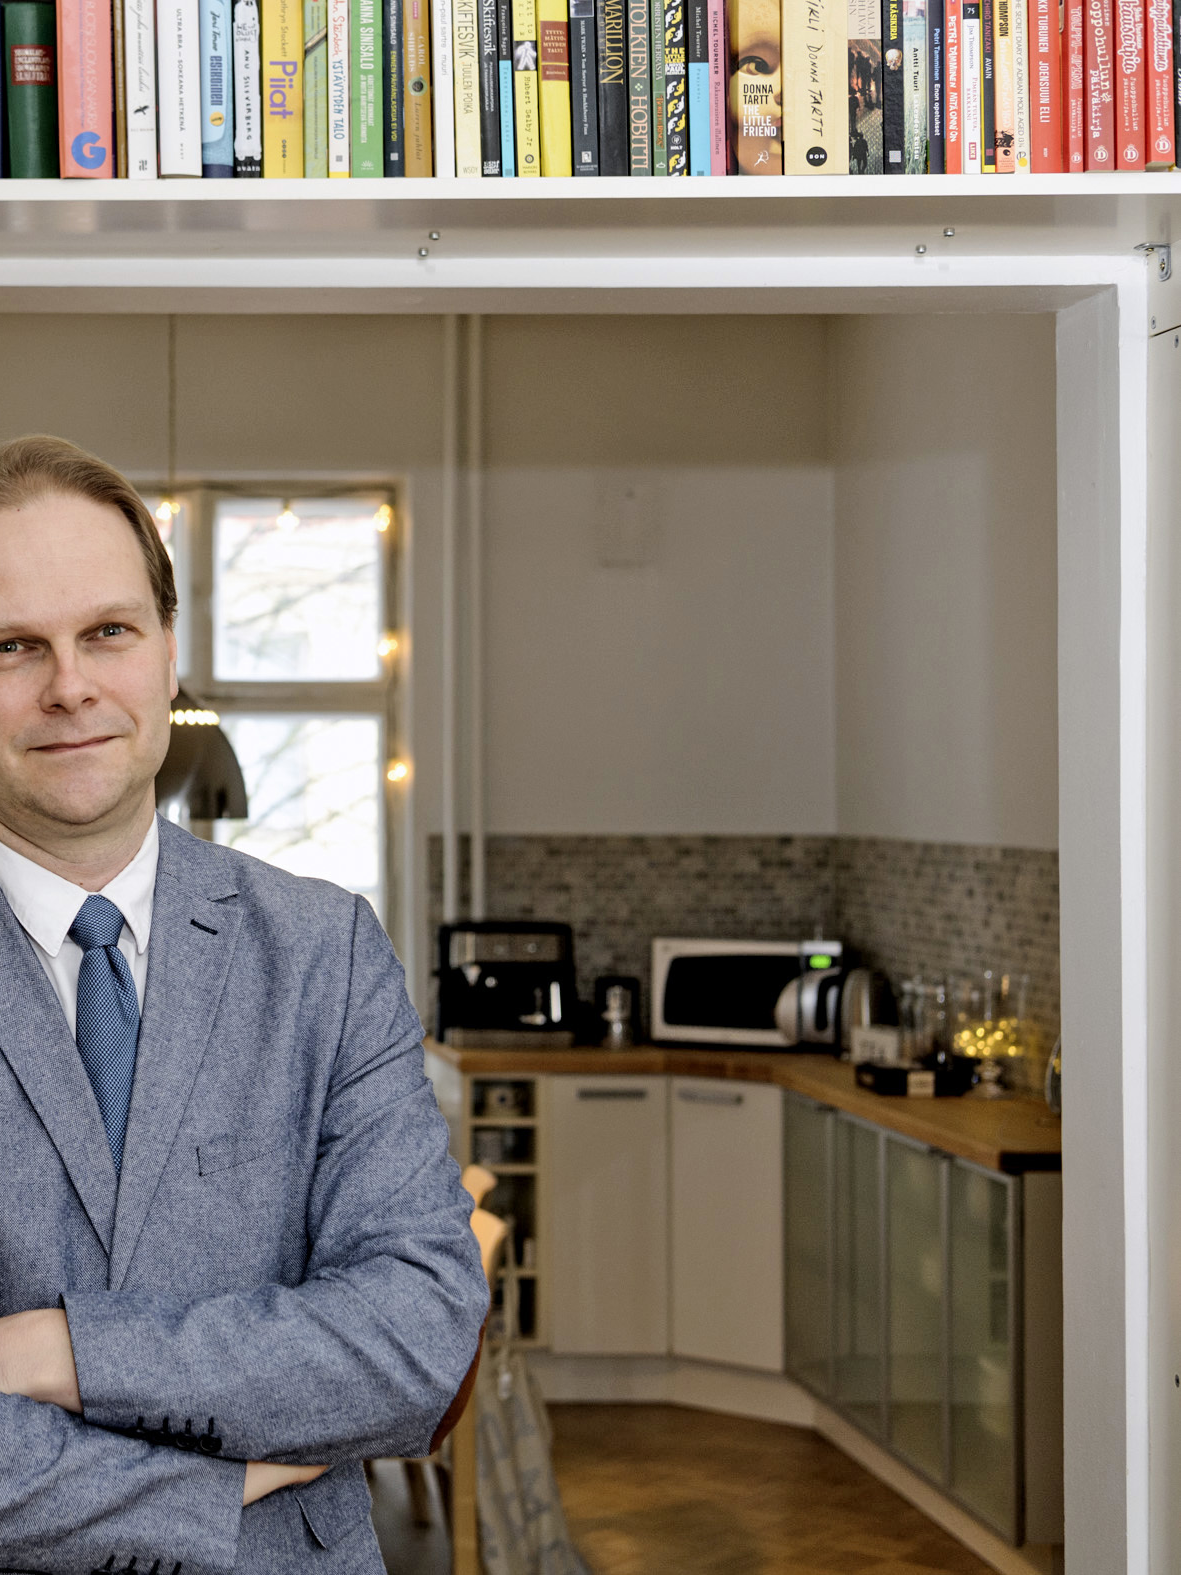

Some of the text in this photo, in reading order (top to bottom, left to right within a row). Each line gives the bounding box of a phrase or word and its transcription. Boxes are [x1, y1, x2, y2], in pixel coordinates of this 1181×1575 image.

[482, 0, 496, 56] Skiftesvik
[890, 3, 899, 41] KÄSIKIRJA
[967, 7, 975, 15] 75
[999, 0, 1009, 37] HOMPSON
[360, 27, 375, 70] SINISALO
[500, 5, 508, 56] Françoise Sagan
[695, 6, 704, 58] Michel Tournier
[1016, 36, 1024, 57] DIARY
[1038, 15, 1049, 53] TURUNEN
[407, 31, 416, 73] SHIELDS
[417, 35, 426, 67] CAROL
[440, 26, 449, 76] sartre muuri
[654, 40, 664, 81] HERRASTA
[912, 47, 920, 68] Antti
[985, 21, 993, 80] TANIZAKI AVAIN
[1017, 57, 1024, 67] OF
[177, 59, 185, 95] SOKEANA
[209, 55, 224, 106] esikoinen
[270, 26, 298, 119] Stockett Piiat
[332, 59, 346, 115] YSTÄVYYDEN
[462, 63, 473, 90] TUULEN
[630, 0, 649, 170] TOLKIEN HOBITTI
[743, 83, 774, 94] DONNA
[1039, 60, 1050, 104] JOENSUUN
[178, 97, 186, 132] HETKENÄ
[390, 73, 398, 122] PÄIVÄNLASKUA
[462, 93, 474, 115] POIKA
[523, 76, 534, 148] Hubert Selby Jr
[743, 94, 769, 105] TARTT
[743, 104, 760, 115] THE
[808, 88, 824, 137] TARTT
[1017, 96, 1025, 116] MOLE
[1039, 106, 1050, 124] ELLI
[1090, 69, 1102, 139] päiväkirja
[333, 117, 346, 140] TALO
[743, 115, 772, 127] LITTLE
[743, 126, 777, 137] FRIEND
[932, 102, 941, 136] opetukset
[463, 166, 479, 174] WSOY
